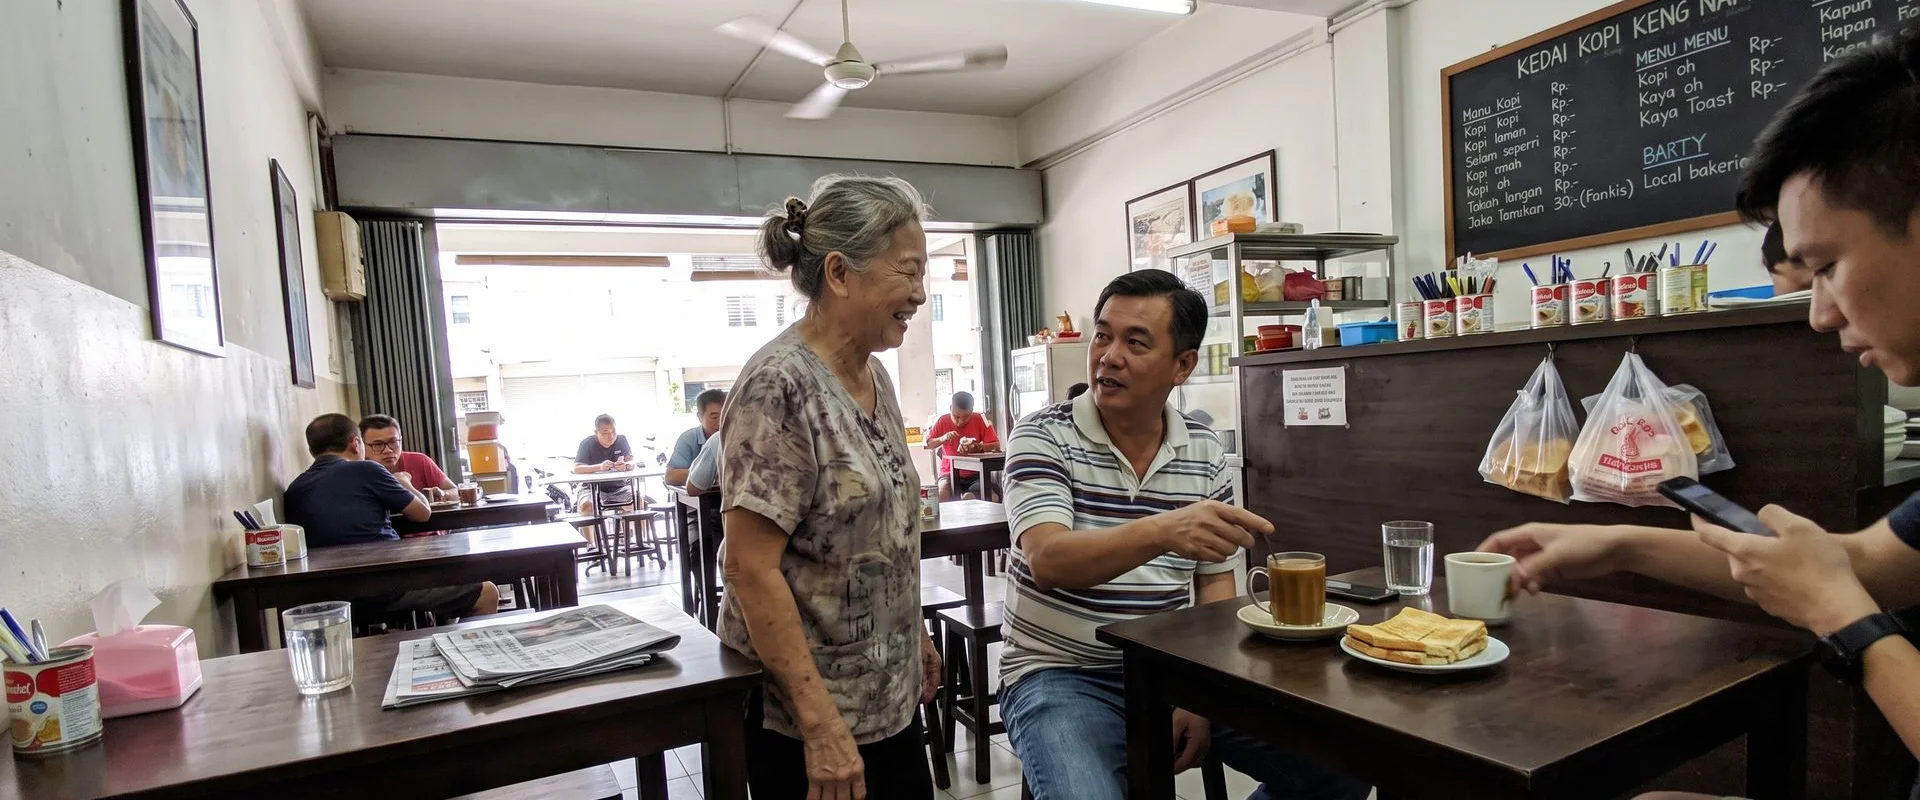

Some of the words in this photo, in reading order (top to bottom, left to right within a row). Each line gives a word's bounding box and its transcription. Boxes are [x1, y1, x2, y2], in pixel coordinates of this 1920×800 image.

[1820, 0, 1872, 24] Kapun
[1517, 43, 1567, 79] KEDAI
[1578, 23, 1620, 58] KOPI
[1633, 0, 1689, 39] KENG
[1821, 17, 1875, 42] Hapan
[1636, 42, 1677, 67] MENU
[1684, 25, 1728, 51] MENU
[1639, 66, 1668, 88] Kopi
[1676, 59, 1695, 76] oh
[1639, 88, 1675, 107] Kaya
[1684, 77, 1703, 94] oh
[1463, 106, 1491, 122] Manu
[1496, 92, 1520, 110] Kopi
[1640, 108, 1678, 128] Kaya
[1686, 87, 1735, 114] Toast
[1464, 121, 1487, 139] Kopi
[1497, 111, 1519, 129] kopi
[1464, 136, 1487, 154] Kopi
[1495, 127, 1526, 144] laman
[1466, 152, 1498, 168] Selam
[1503, 135, 1540, 157] seperri
[1643, 132, 1707, 165] BARTY
[1466, 166, 1488, 183] Kopi
[1467, 181, 1489, 198] Kopi
[1497, 176, 1510, 190] oh
[1644, 166, 1681, 189] Local
[1505, 186, 1542, 204] langan
[1468, 213, 1493, 229] Jako
